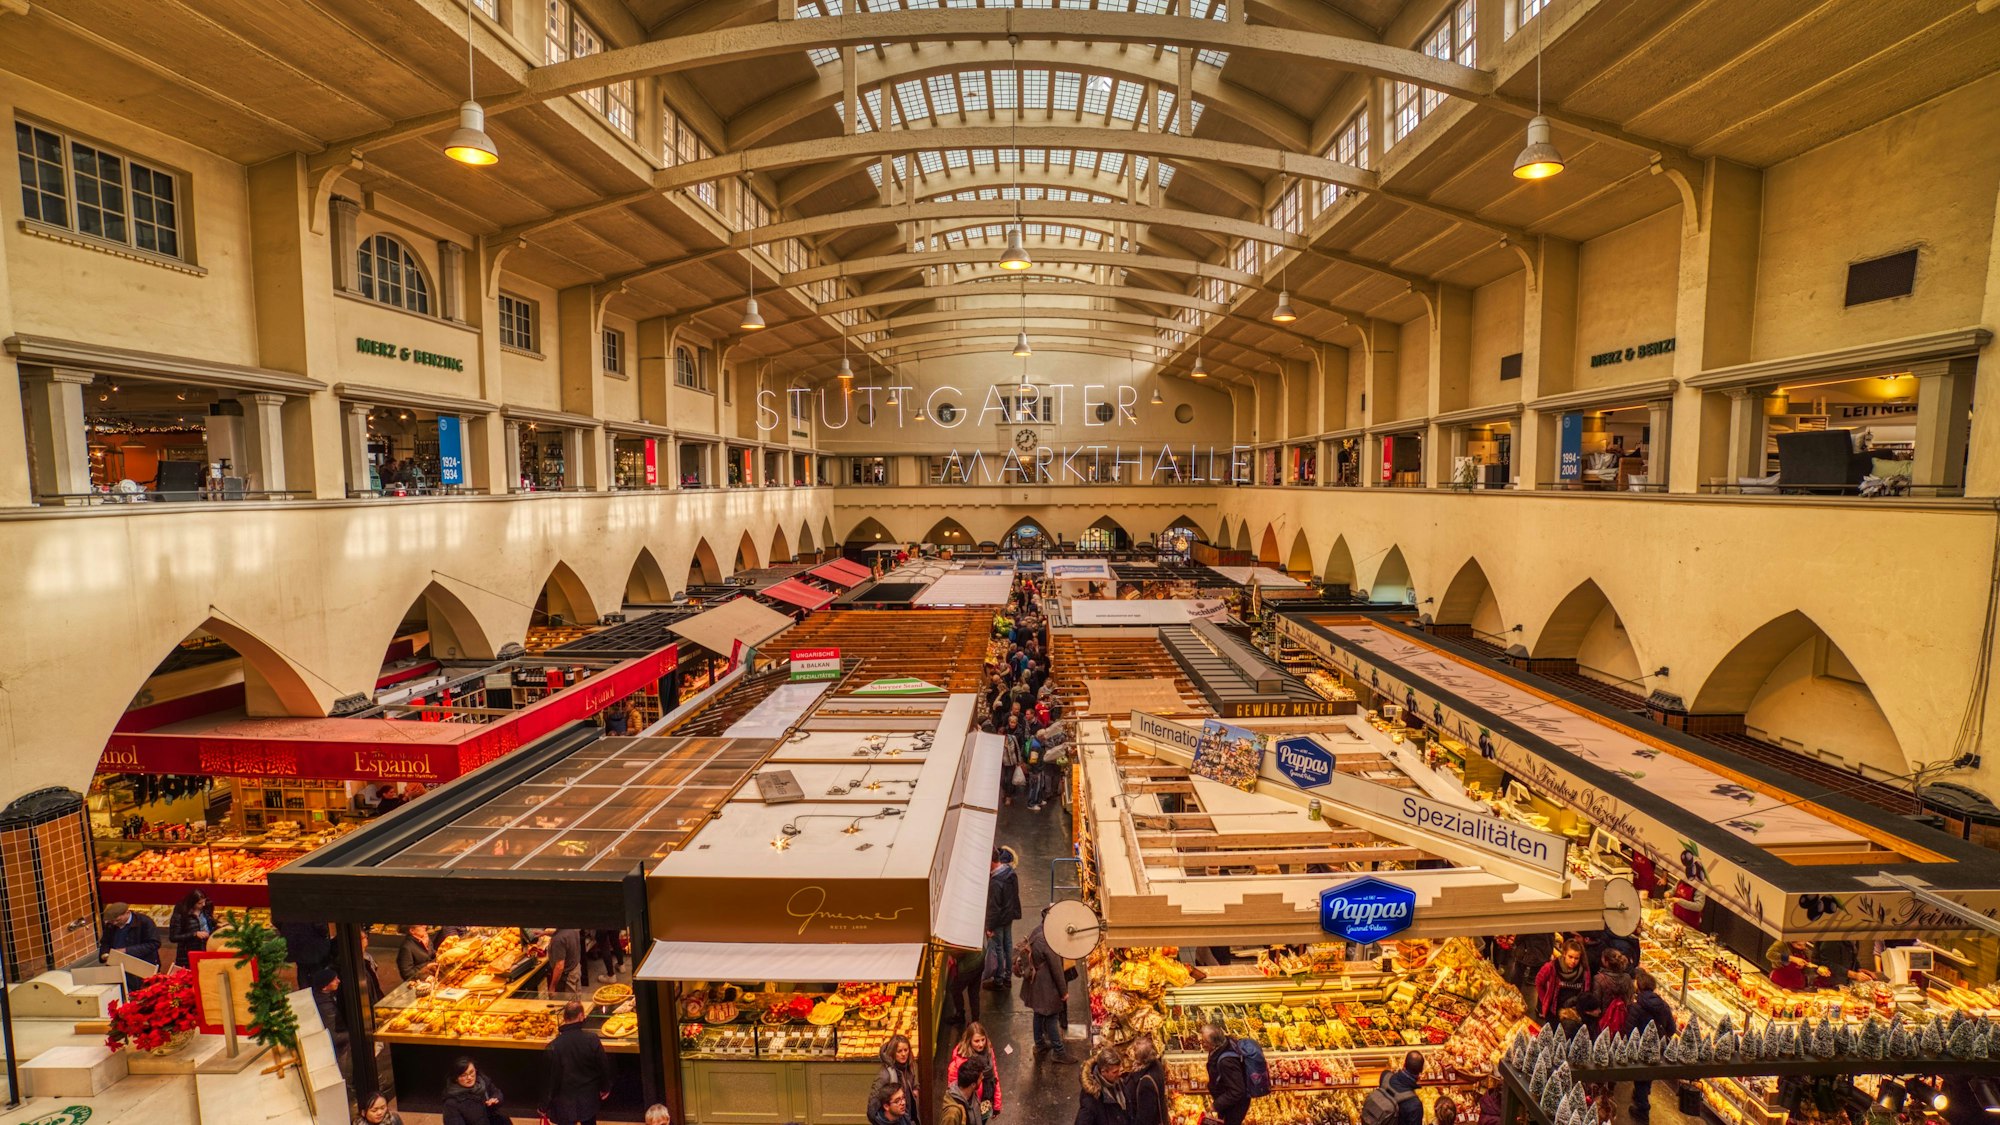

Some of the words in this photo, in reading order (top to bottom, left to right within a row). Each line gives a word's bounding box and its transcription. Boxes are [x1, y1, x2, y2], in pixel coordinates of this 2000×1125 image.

[357, 337, 396, 359] MERZ
[400, 348, 411, 361] &
[414, 350, 463, 372] BENZING
[1591, 350, 1622, 368] MERZ
[1625, 348, 1635, 361] &
[755, 384, 1138, 431] STUTTGARTER
[940, 444, 1251, 482] MARKTHALLE
[1562, 453, 1580, 464] 1994-
[443, 468, 457, 480] 1934
[1562, 464, 1577, 475] 2004
[795, 672, 836, 680] SPEZIALITÄTEN
[1236, 703, 1286, 717] GEWÜRZ
[1293, 703, 1334, 716] MAYER
[1279, 744, 1329, 776] Pappas
[1402, 797, 1548, 860] Spezialitäten
[1329, 896, 1408, 925] Pappas
[1346, 924, 1368, 935] Gourmet
